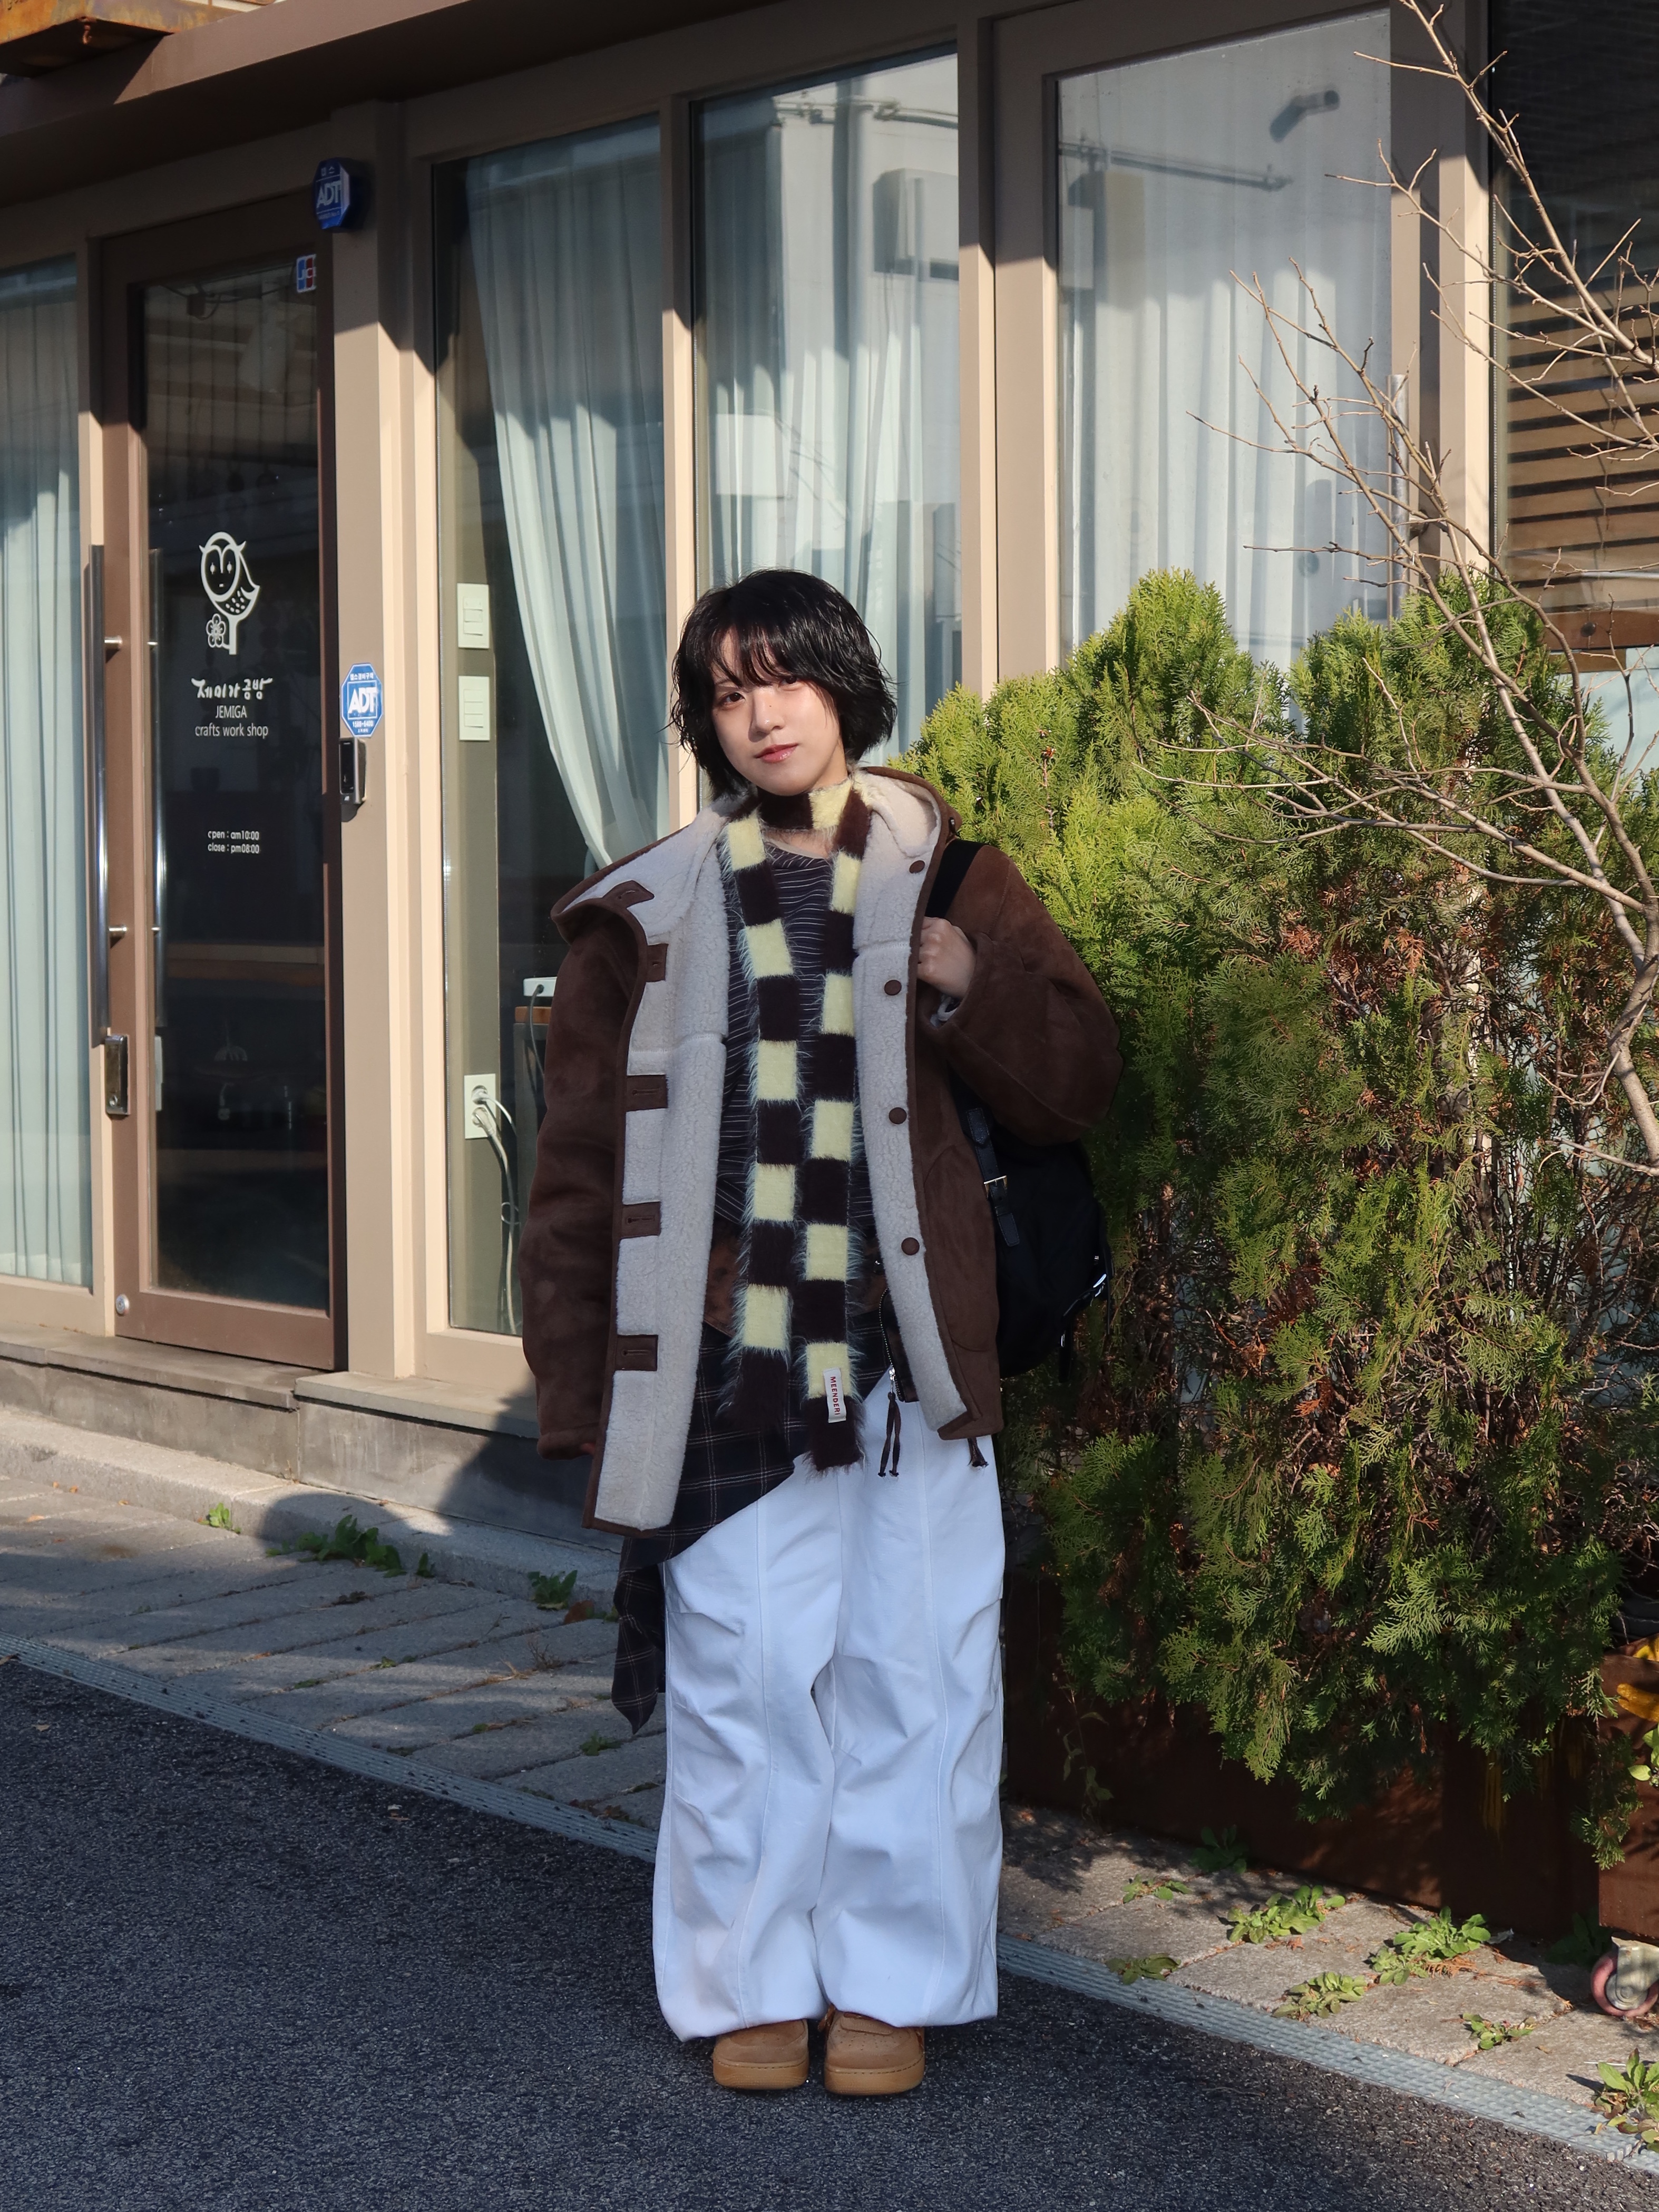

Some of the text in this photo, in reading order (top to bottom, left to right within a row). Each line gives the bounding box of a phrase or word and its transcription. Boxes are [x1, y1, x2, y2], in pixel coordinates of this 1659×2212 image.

[316, 181, 341, 208] ADT
[191, 678, 273, 700] 제미가 공방
[348, 687, 377, 714] ADT
[216, 705, 247, 718] JEMIGA
[195, 723, 268, 739] crafts work shop
[231, 831, 260, 841] am10:00
[208, 842, 225, 852] close
[231, 844, 260, 854] pm08:00
[830, 1376, 841, 1415] MEENDERI
